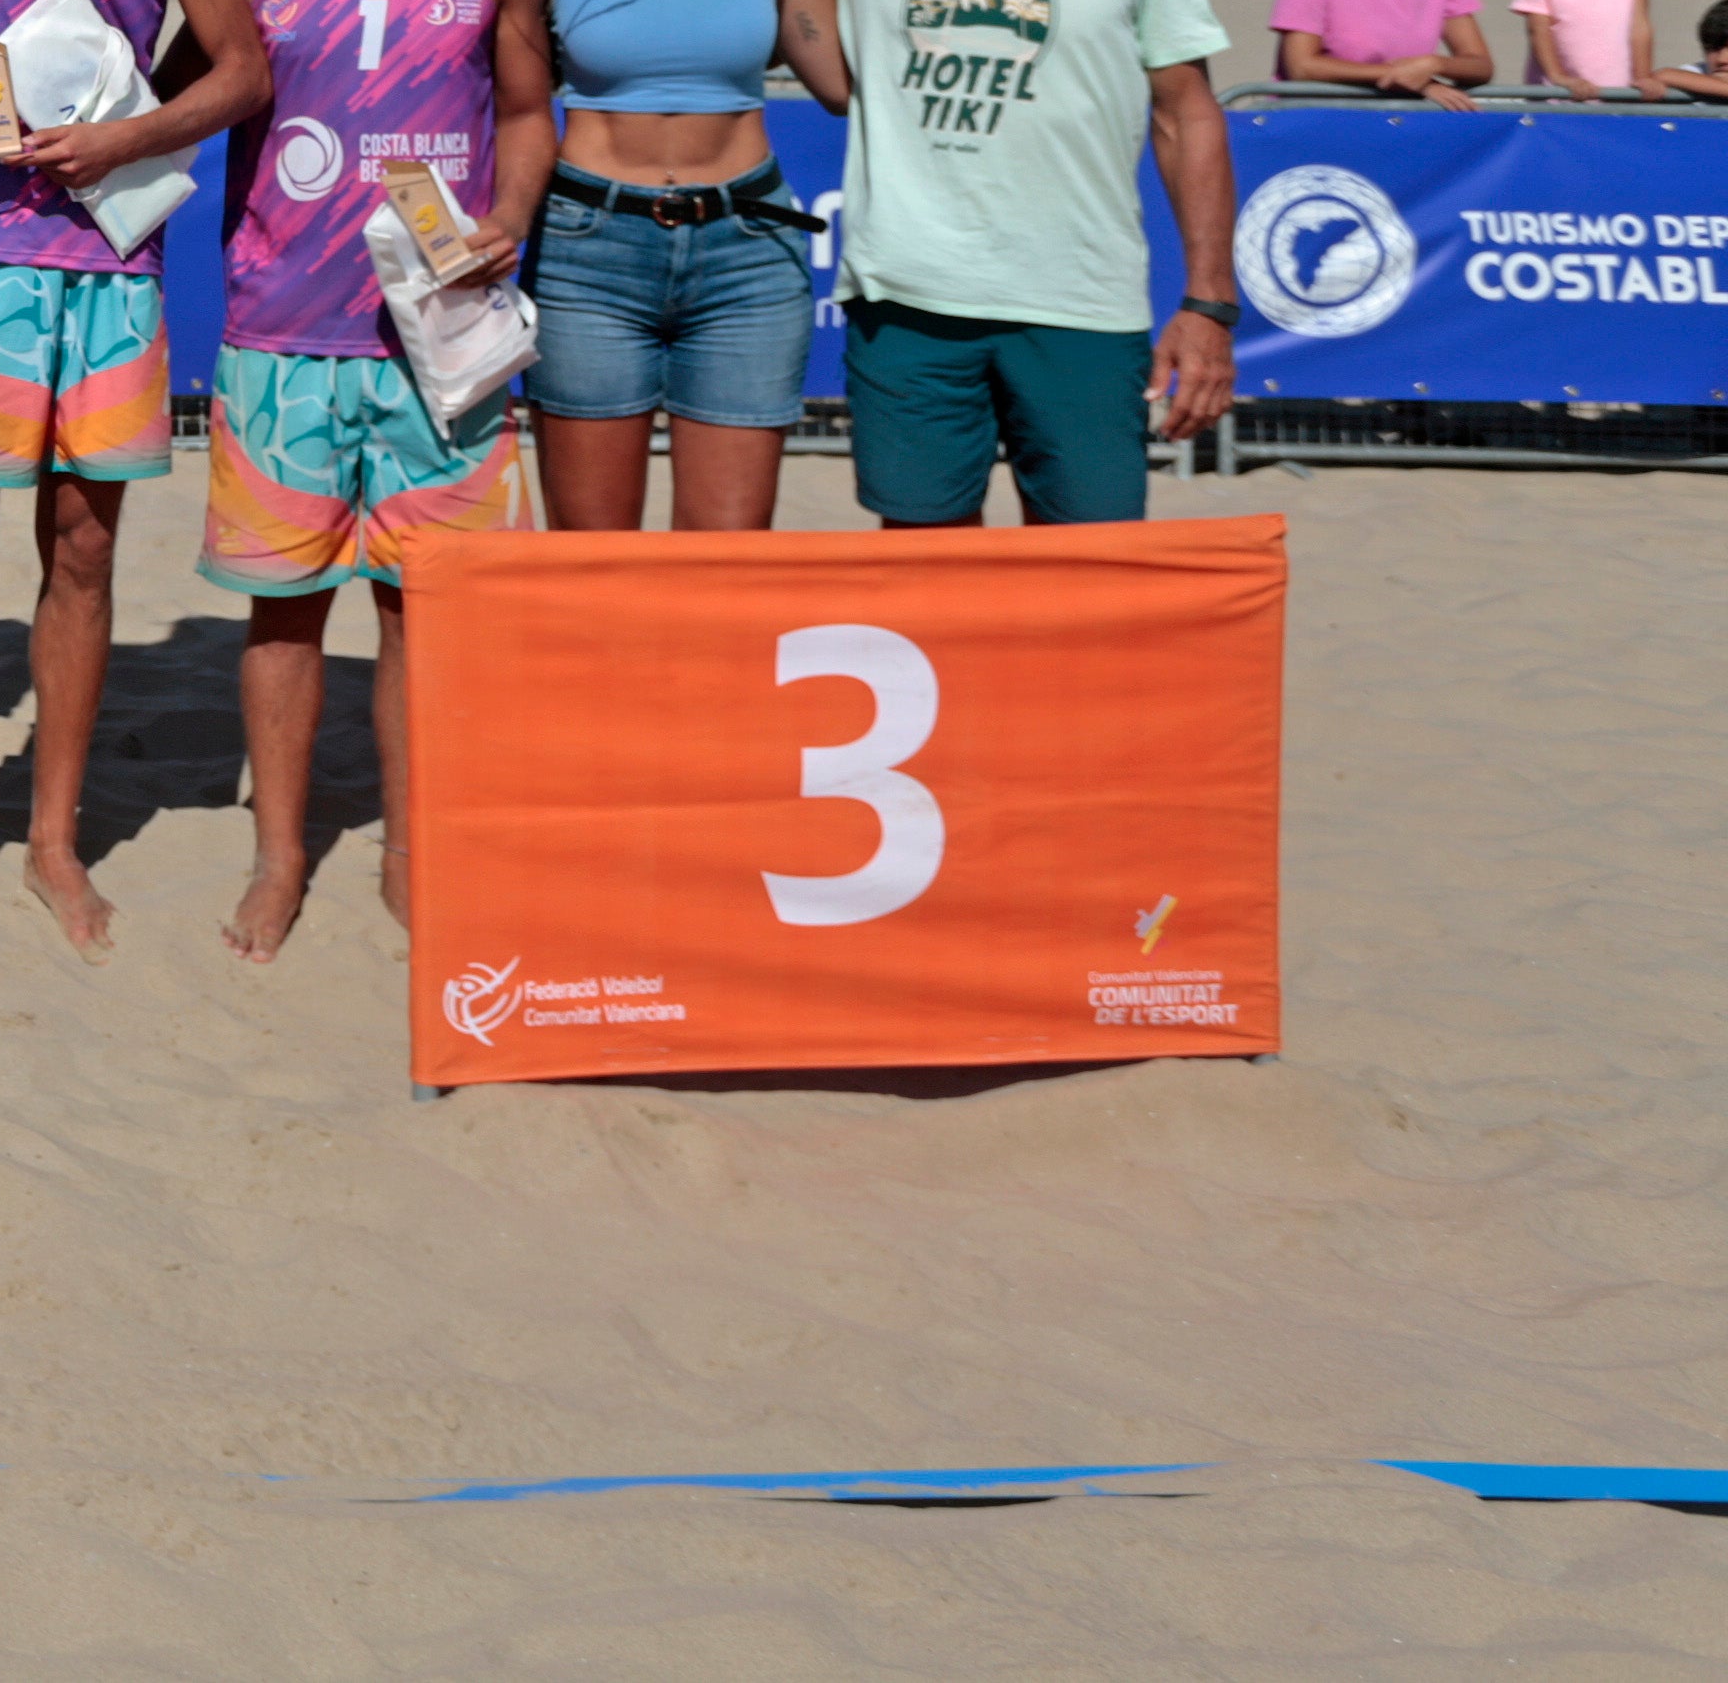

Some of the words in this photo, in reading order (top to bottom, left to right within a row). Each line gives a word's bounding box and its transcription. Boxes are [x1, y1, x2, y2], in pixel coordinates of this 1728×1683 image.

[901, 50, 1037, 103] HOTEL
[919, 94, 1004, 136] TIKI
[359, 132, 411, 157] COSTA
[413, 132, 470, 156] BLANCA
[1459, 208, 1647, 248] TURISMO
[759, 622, 946, 928] 3
[601, 973, 664, 997] Voleibol
[1087, 982, 1223, 1008] COMUNITAT
[523, 1005, 602, 1028] Comunitat
[602, 1001, 687, 1023] Valenciana
[1094, 1005, 1129, 1026] DE
[1131, 1002, 1240, 1026] L'ESPORT
